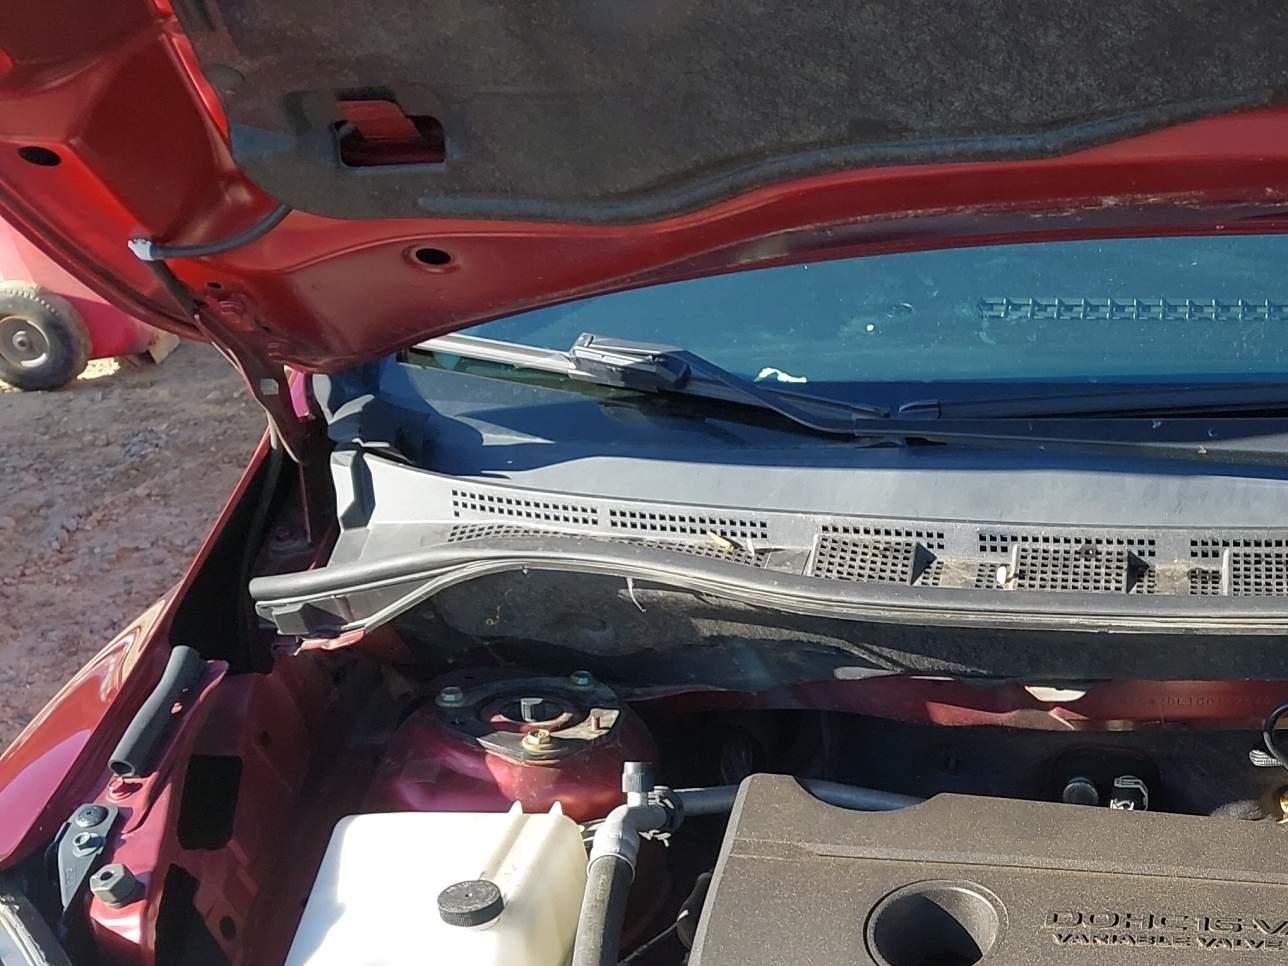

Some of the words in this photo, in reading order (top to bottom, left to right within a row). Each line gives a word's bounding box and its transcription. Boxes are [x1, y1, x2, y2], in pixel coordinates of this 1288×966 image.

[1042, 910, 1189, 931] DOHC
[1052, 932, 1192, 948] VARIABLE
[1196, 936, 1284, 952] VALVE
